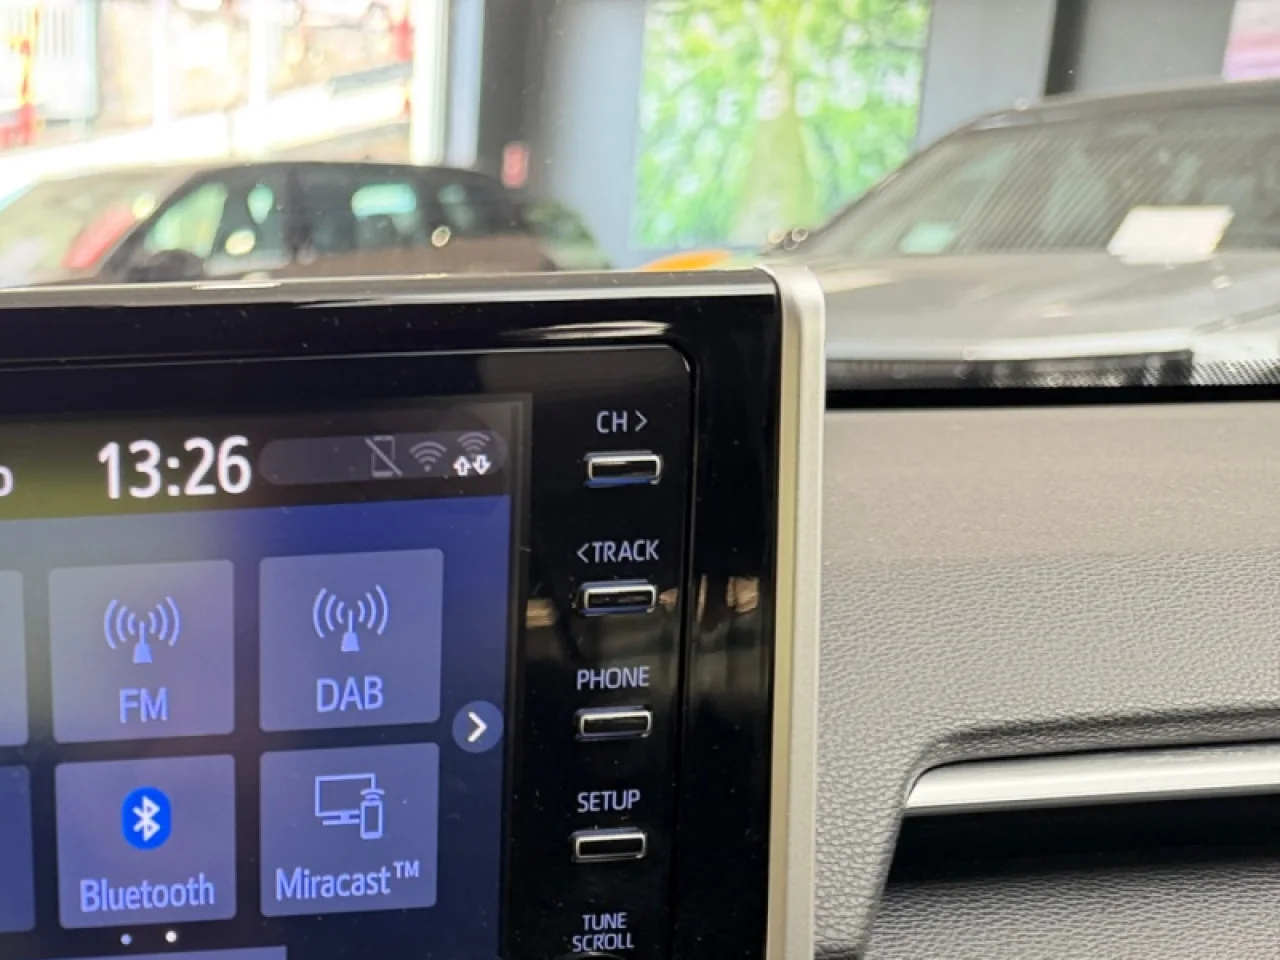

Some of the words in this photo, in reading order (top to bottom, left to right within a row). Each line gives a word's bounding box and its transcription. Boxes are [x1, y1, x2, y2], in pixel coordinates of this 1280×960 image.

[98, 436, 252, 499] 13:26
[577, 666, 650, 690] PHONE
[120, 688, 168, 723] FM
[316, 677, 384, 713] DAB
[577, 789, 640, 812] SETUP
[80, 874, 215, 913] Bluetooth
[582, 912, 627, 932] TUNE
[572, 931, 634, 953] SCROLL
